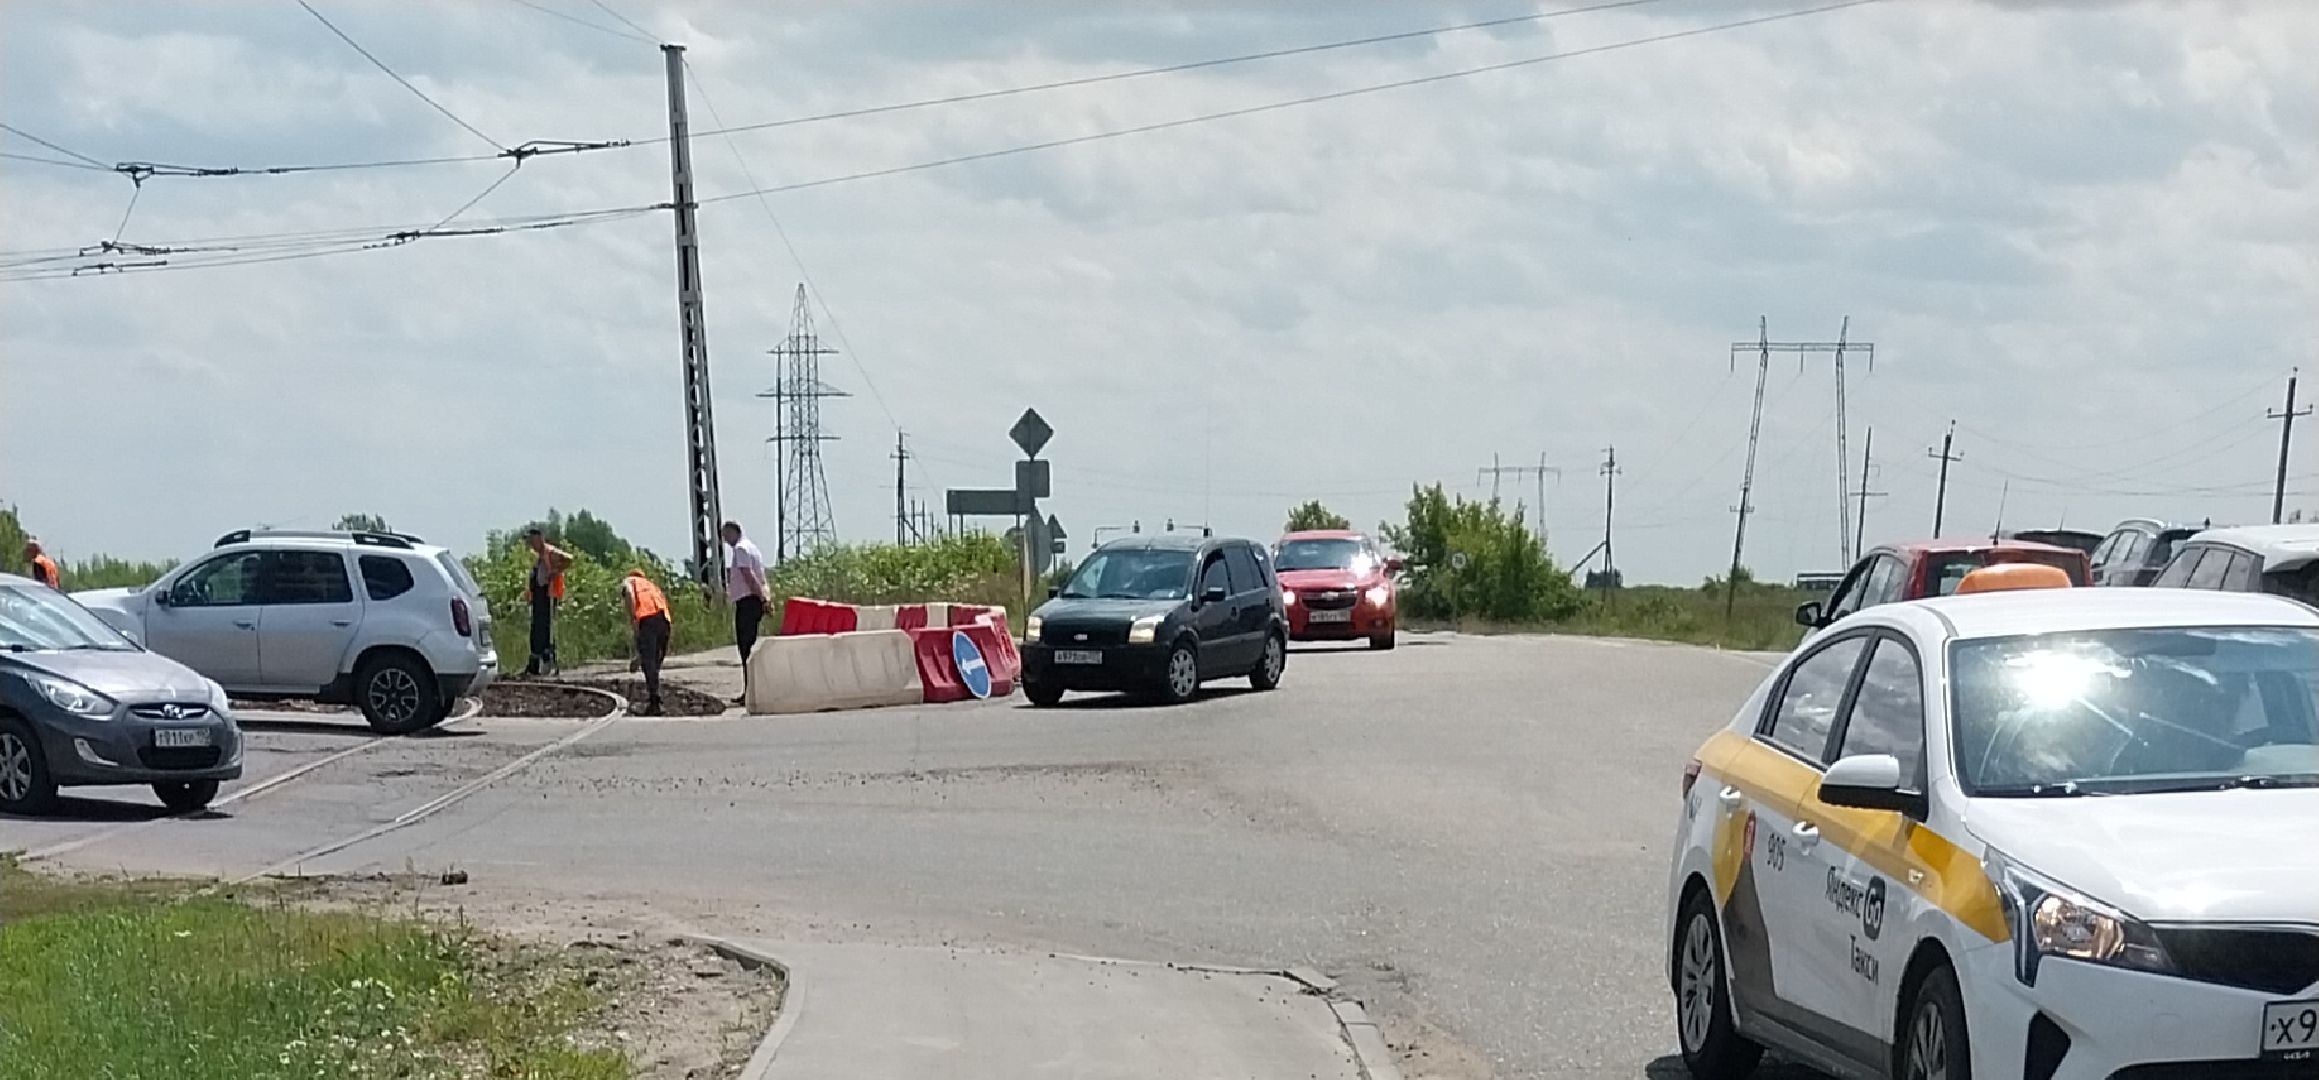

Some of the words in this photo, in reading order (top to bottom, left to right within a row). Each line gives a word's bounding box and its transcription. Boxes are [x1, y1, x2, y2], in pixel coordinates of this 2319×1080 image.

[1767, 832, 1786, 872] 905
[1825, 865, 1864, 918] Яндекс
[1850, 934, 1879, 986] Такси
